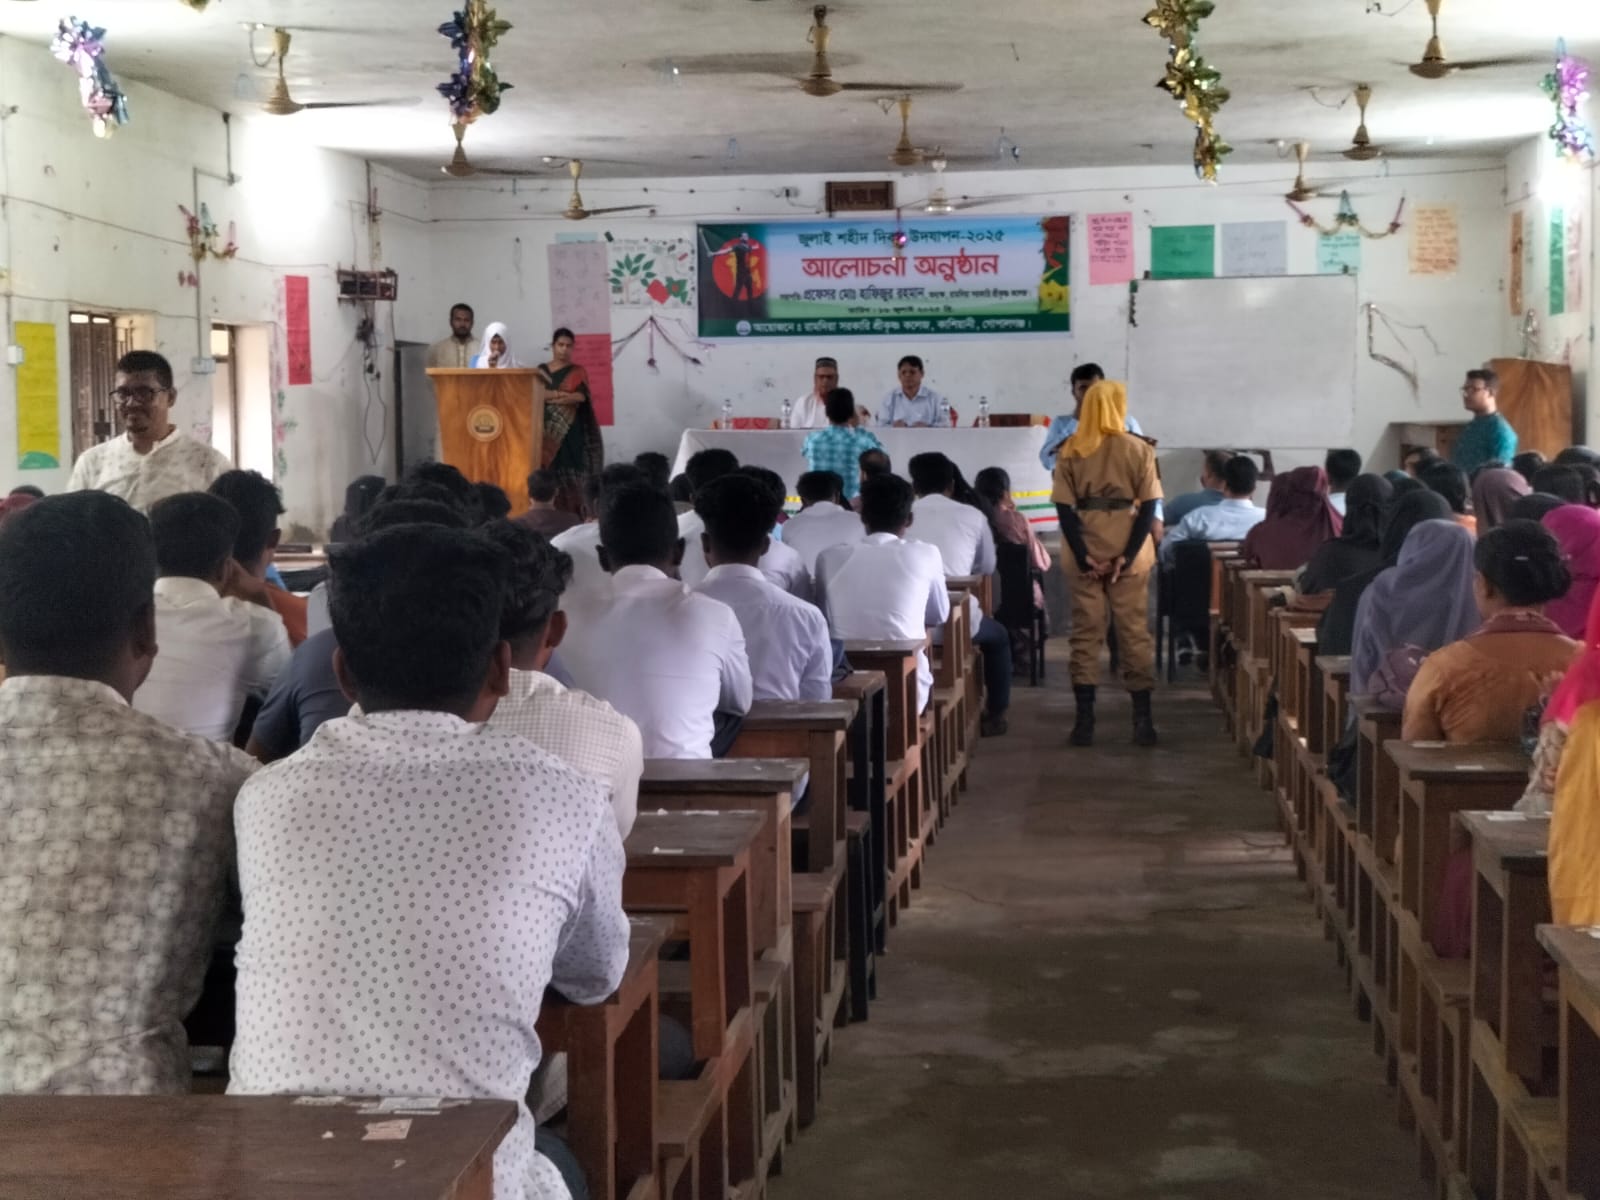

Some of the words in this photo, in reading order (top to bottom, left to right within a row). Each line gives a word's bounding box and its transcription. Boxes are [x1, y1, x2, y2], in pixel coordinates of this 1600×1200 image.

[798, 229, 833, 247] জুলাই
[837, 228, 869, 246] শহীদ
[909, 228, 1005, 244] উদযাপন-২০২৫
[801, 256, 907, 279] আলোচনা
[913, 247, 1000, 283] অনুষ্ঠান
